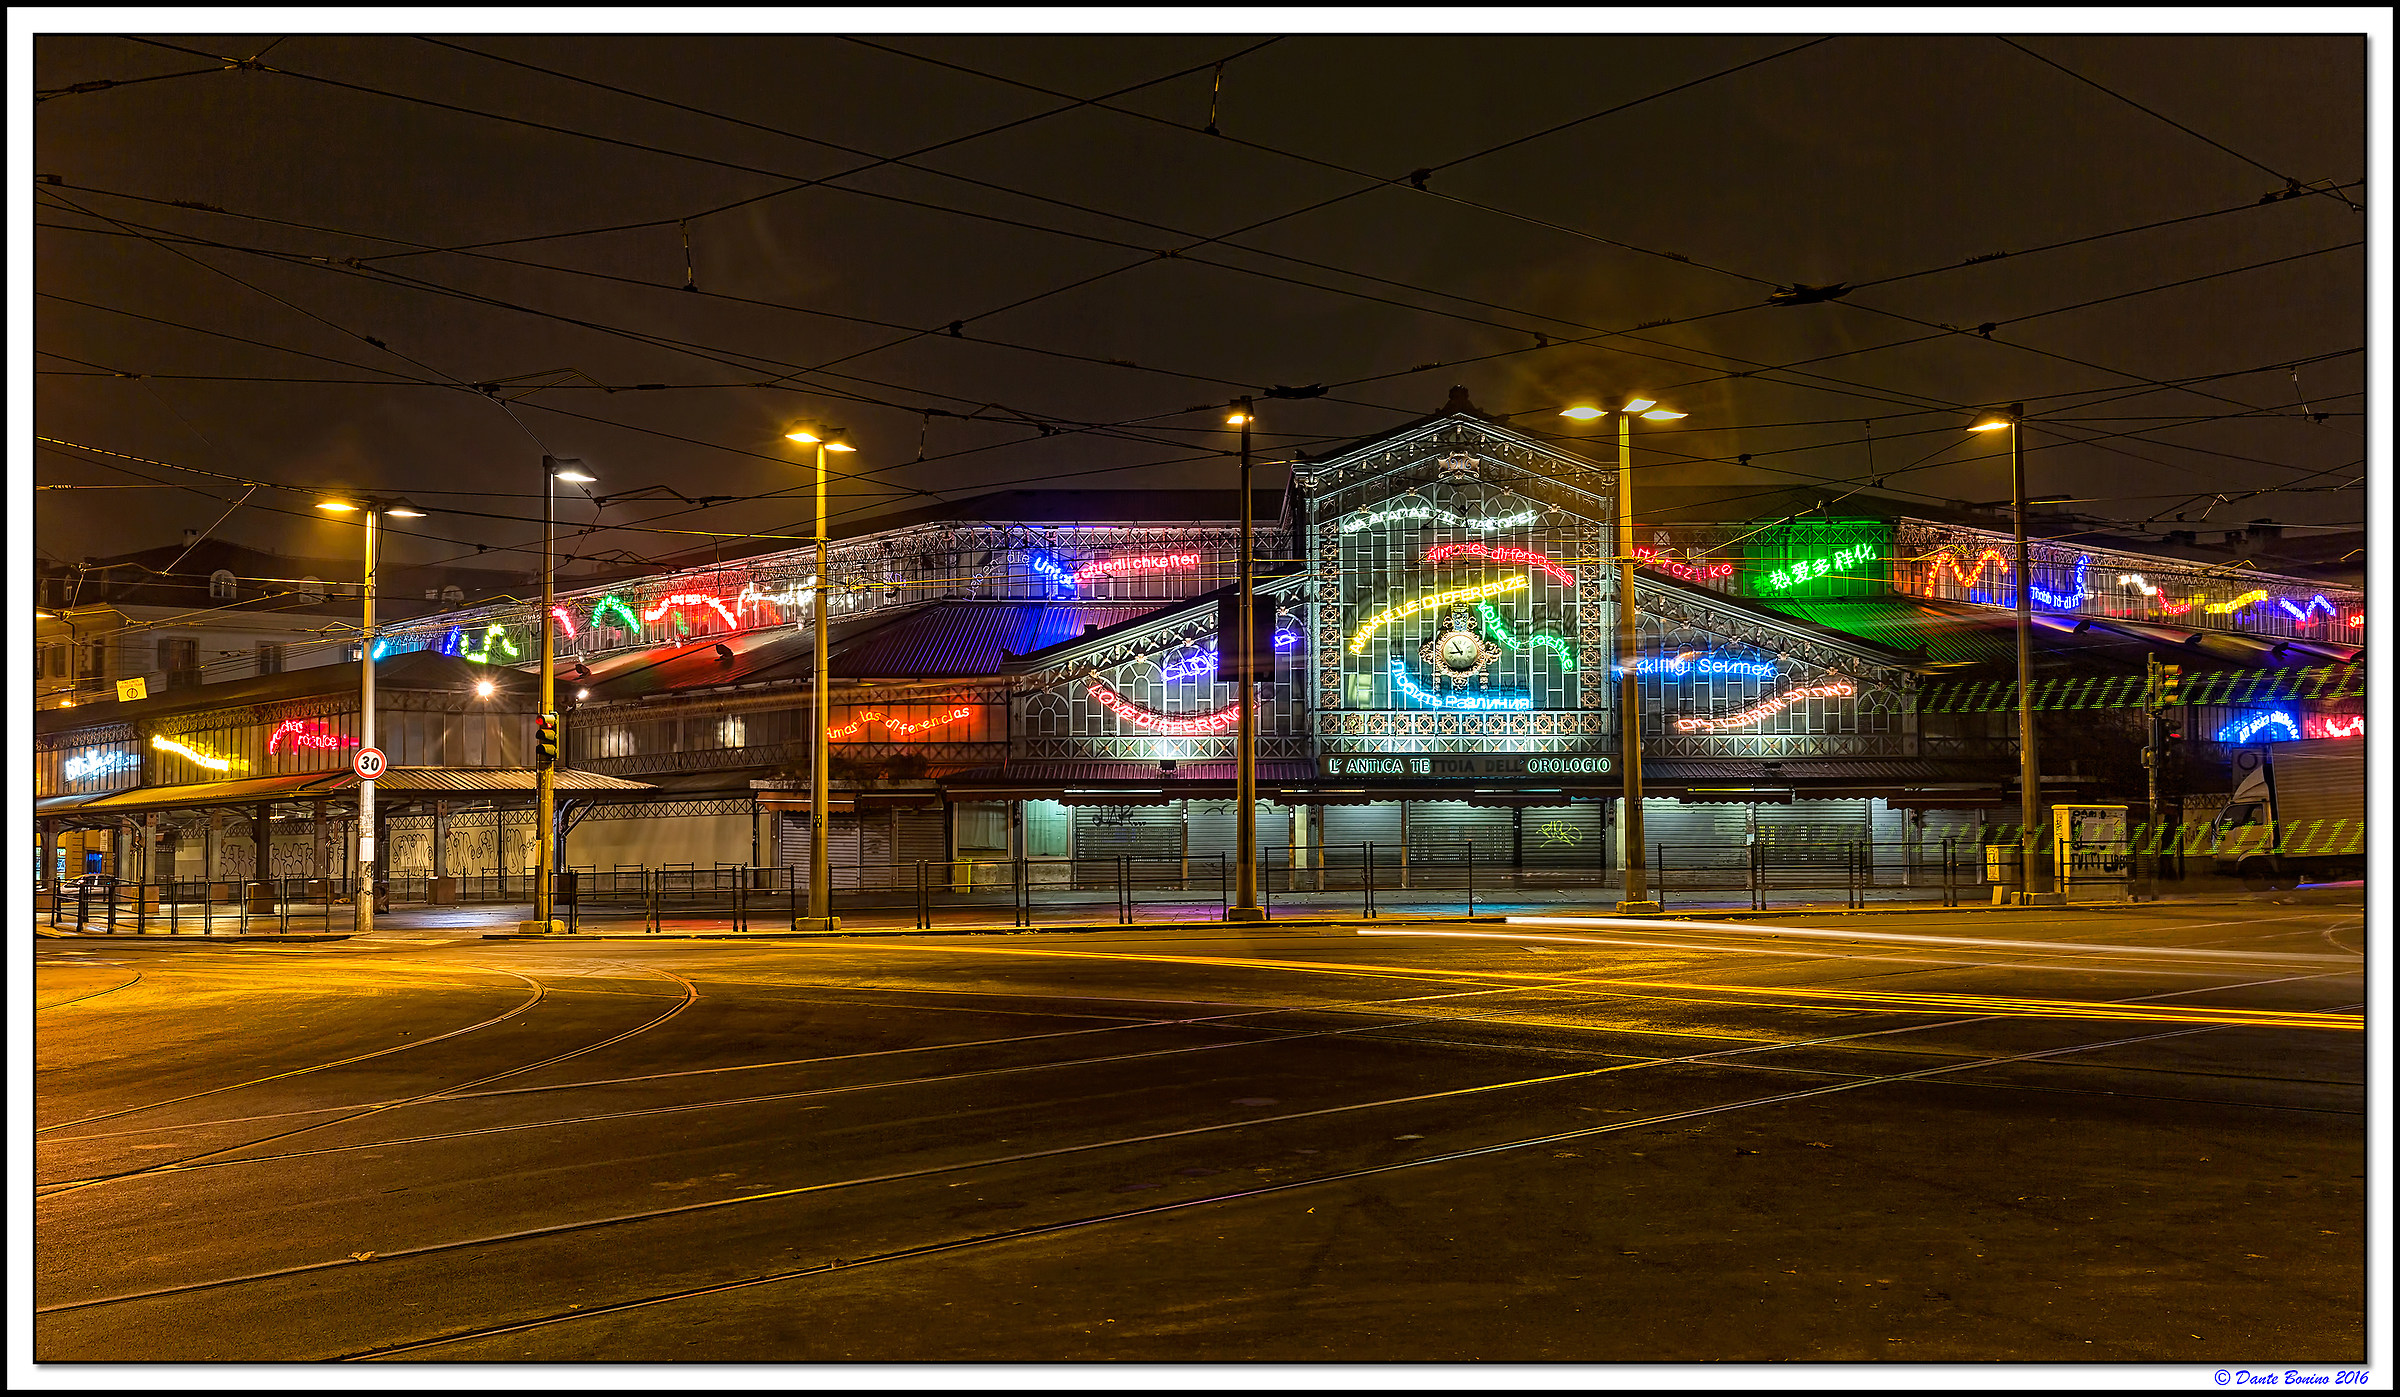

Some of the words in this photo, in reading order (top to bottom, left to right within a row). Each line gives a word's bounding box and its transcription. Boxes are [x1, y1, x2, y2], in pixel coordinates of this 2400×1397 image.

[1662, 558, 1733, 582] razlike
[1349, 608, 1396, 656] AMARE
[1422, 575, 1529, 610] DIFFERENZE
[1088, 684, 1137, 721] LOVE
[860, 710, 882, 723] las
[361, 755, 380, 771] 30
[1346, 758, 1403, 774] ANTICA
[1410, 758, 1475, 774] TETTOIA
[1528, 758, 1611, 774] OROLOGIO
